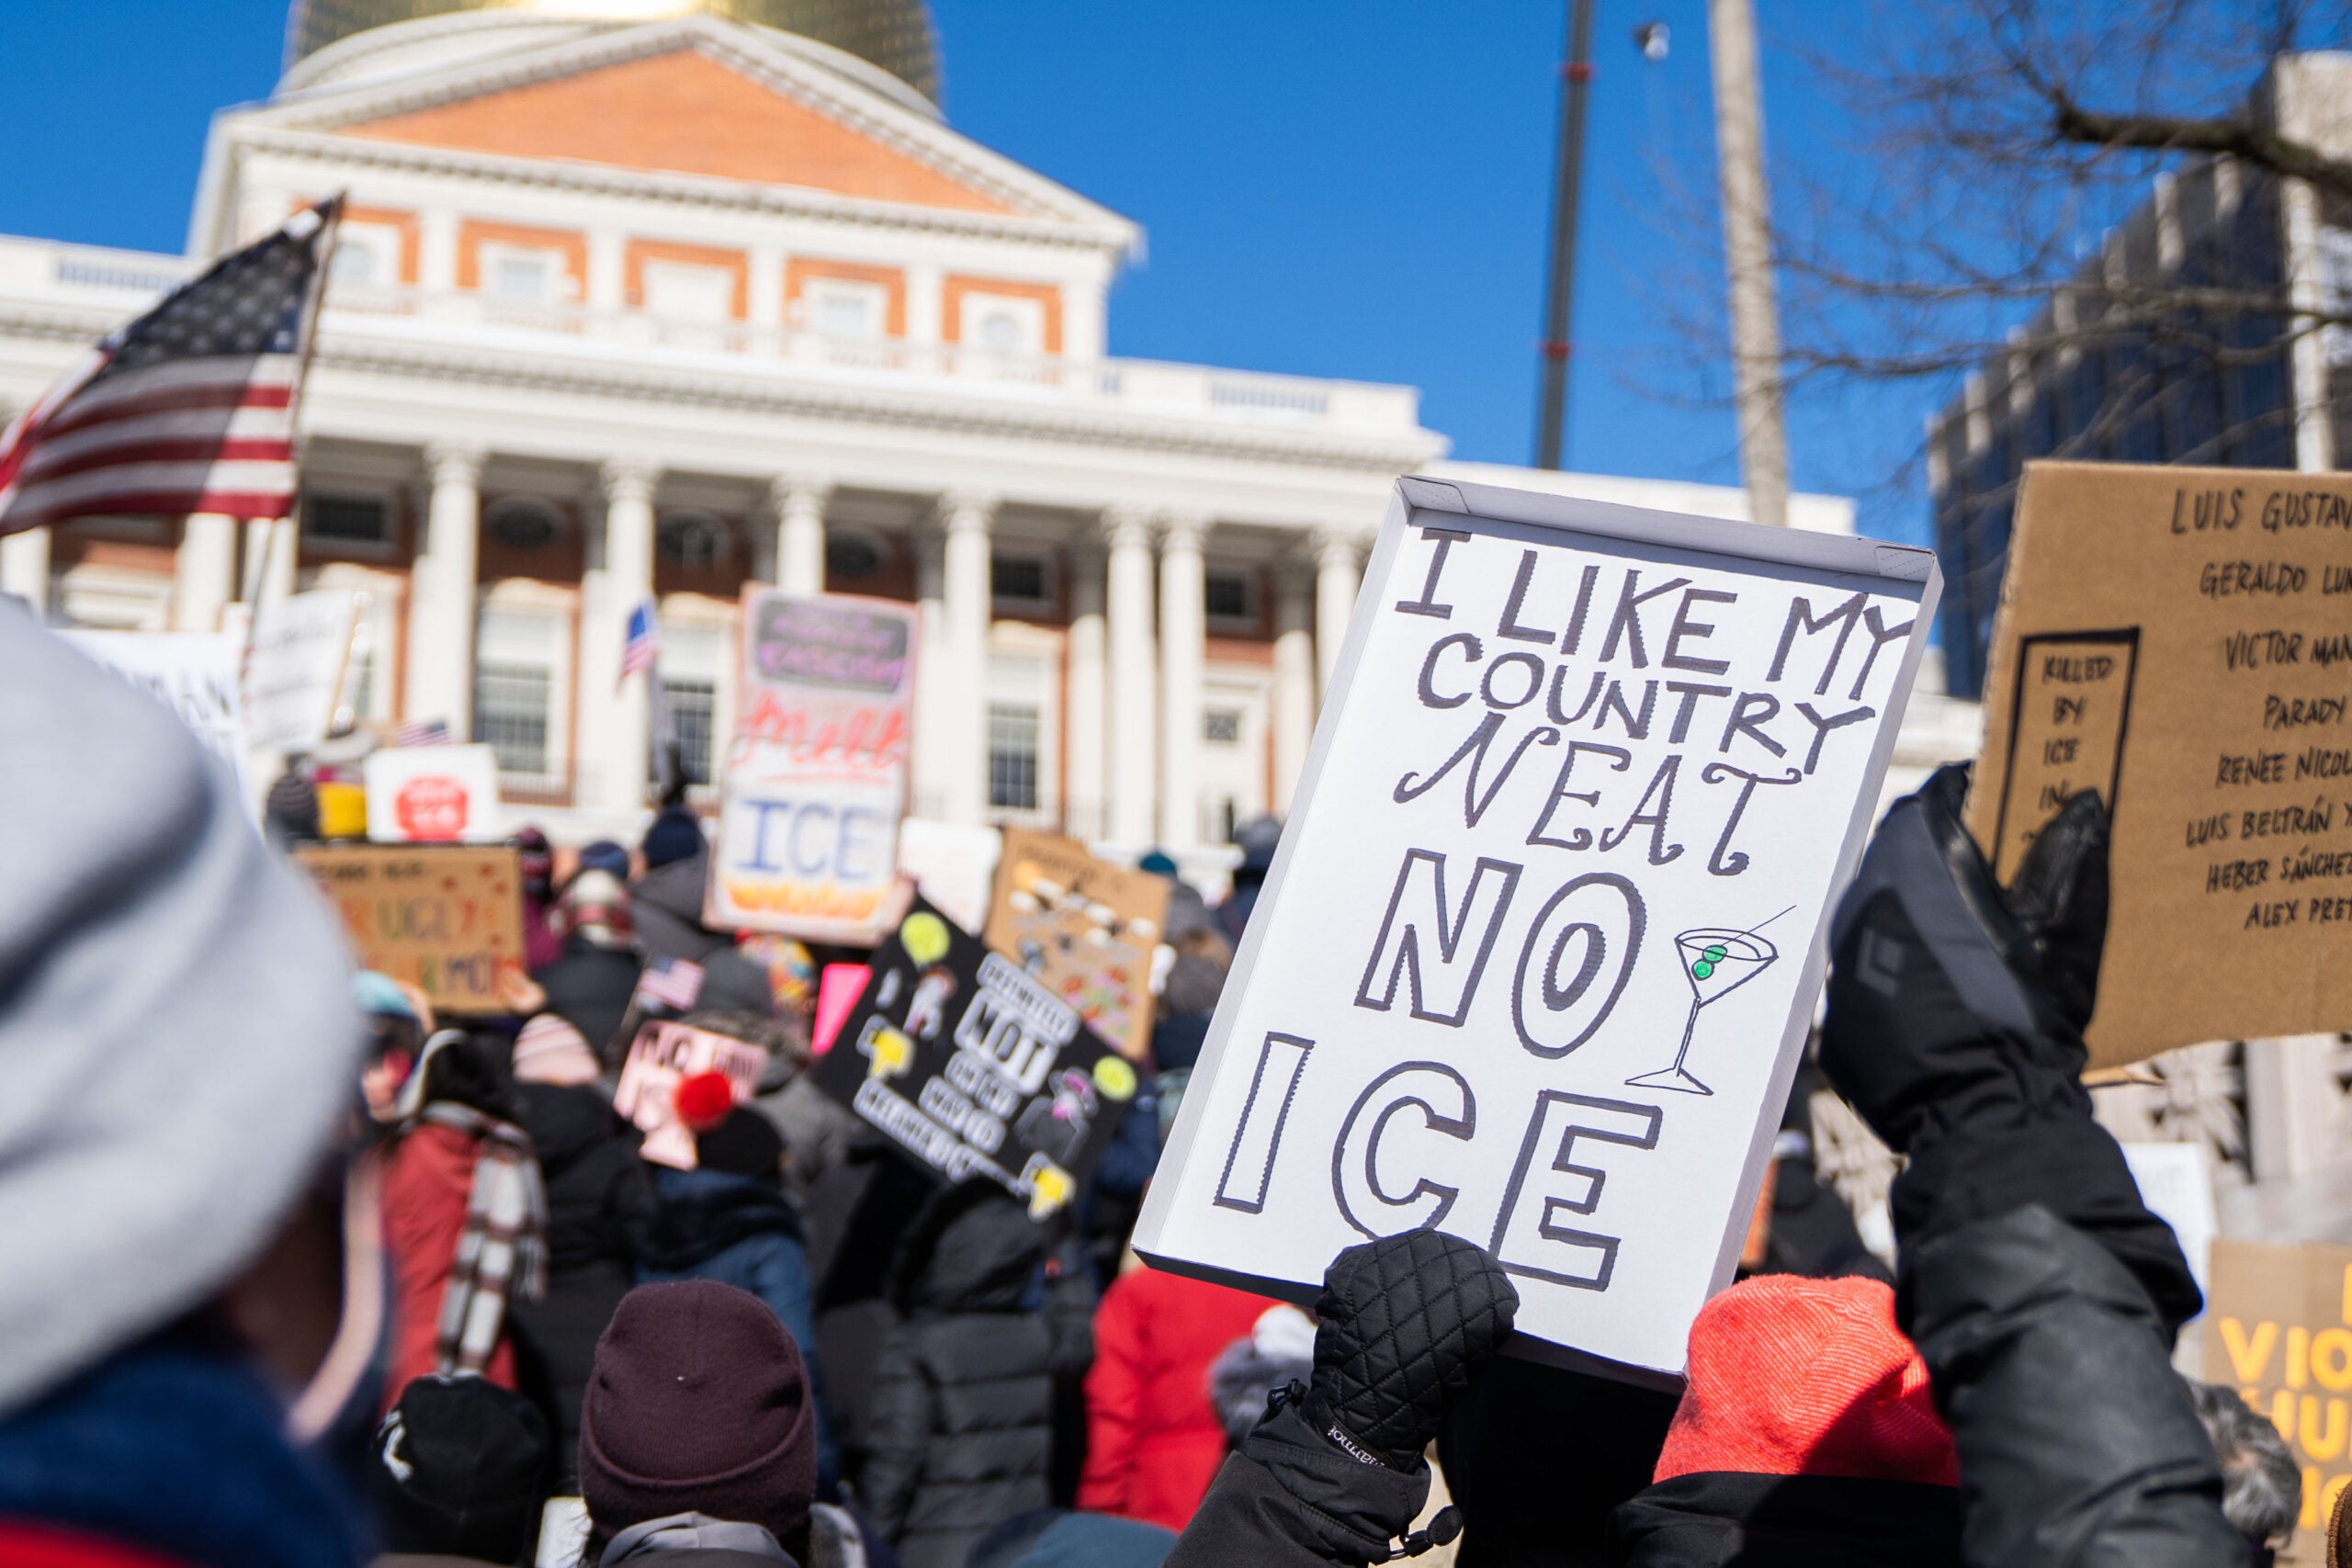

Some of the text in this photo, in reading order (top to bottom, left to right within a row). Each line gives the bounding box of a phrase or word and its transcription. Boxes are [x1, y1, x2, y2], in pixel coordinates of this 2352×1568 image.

[2170, 488, 2245, 534] LUIS
[2199, 560, 2308, 599] GERALDO
[1395, 528, 1914, 700] I LIKE MY
[2041, 655, 2114, 684] KILLED
[2224, 630, 2302, 671] VICTOR
[1418, 633, 1875, 775] COUNTRY
[2052, 695, 2086, 725] BY
[2263, 694, 2346, 730] PARADY
[2042, 738, 2081, 766] ICE
[1393, 712, 1802, 876] NEAT
[737, 798, 882, 880] ICE
[2186, 812, 2232, 848] LUIS
[2240, 795, 2333, 840] BELTRÁN
[2206, 859, 2269, 894] HEBER
[2244, 898, 2300, 931] ALEX
[1353, 849, 1646, 1059] NO
[967, 1001, 1047, 1078] NOT
[1212, 1032, 1663, 1292] ICE
[2218, 1316, 2352, 1392] VIO
